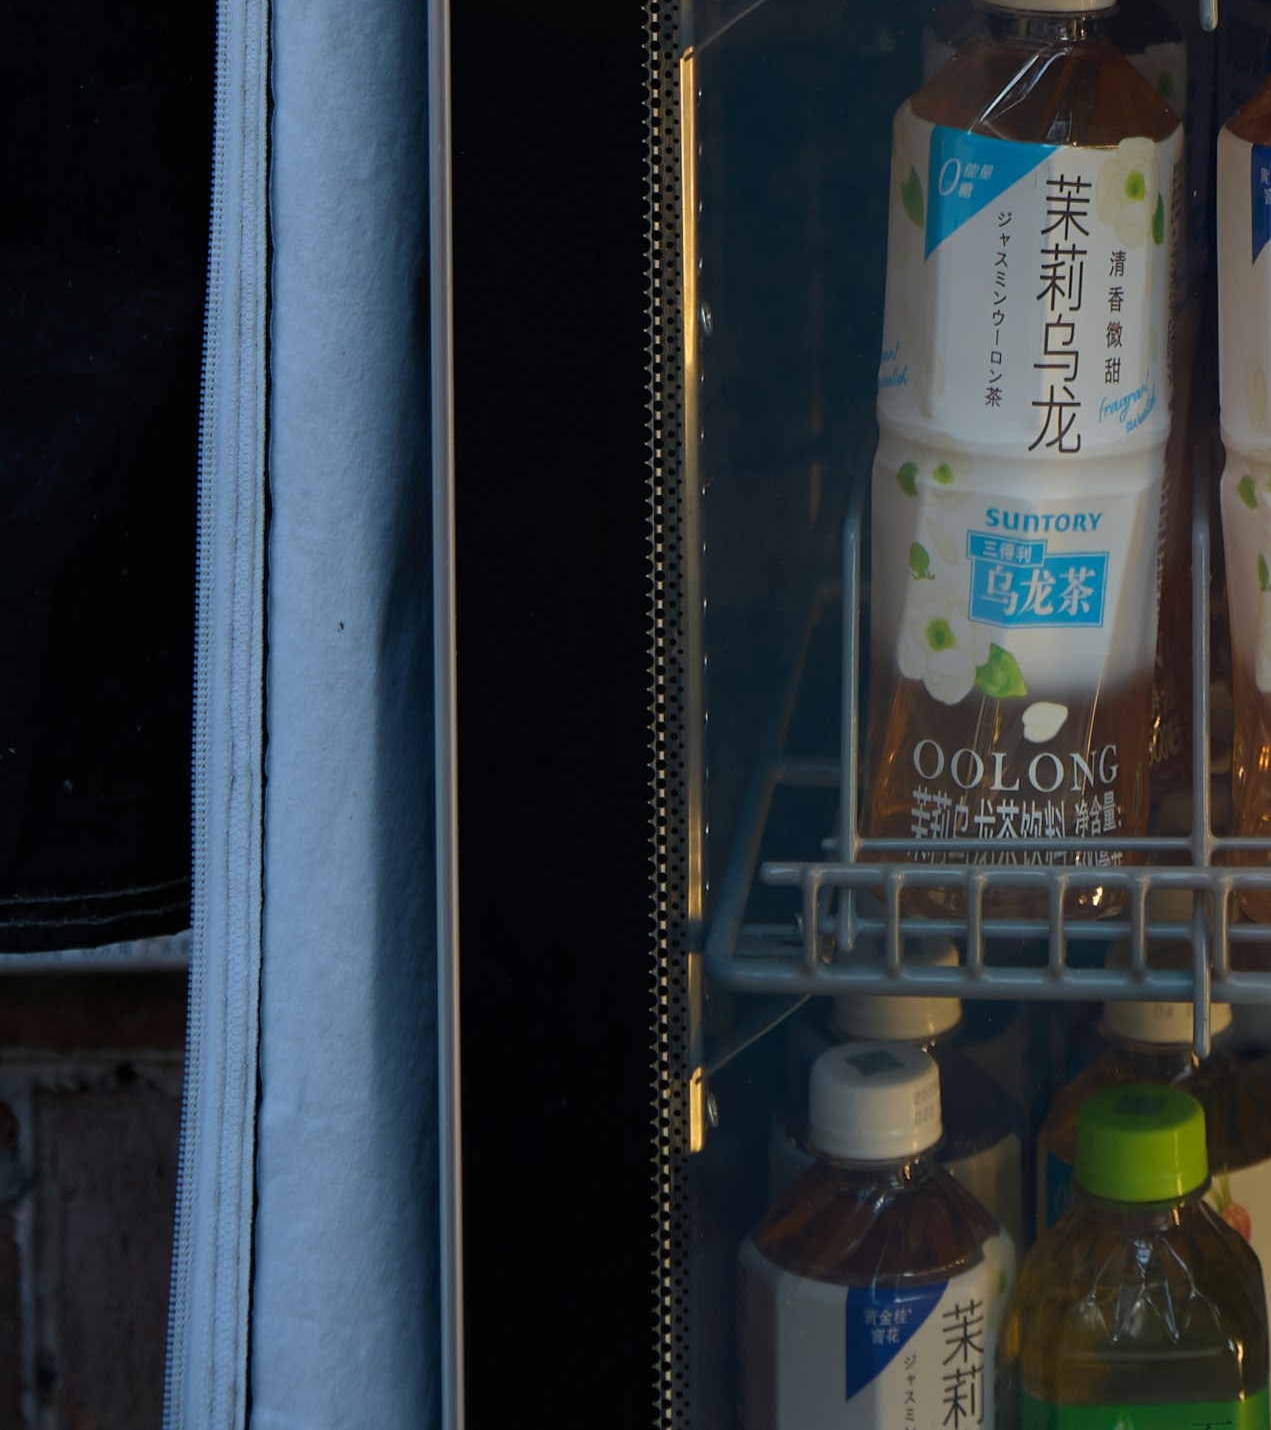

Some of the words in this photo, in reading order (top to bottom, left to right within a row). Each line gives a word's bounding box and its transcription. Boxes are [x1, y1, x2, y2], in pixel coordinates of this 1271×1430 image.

[984, 211, 1013, 408] ジャスミンウーロン茶
[1027, 172, 1092, 455] 茉莉乌龙
[1103, 249, 1128, 386] 清香微甜
[985, 508, 1103, 535] SUNTORY
[981, 566, 1099, 619] 乌龙茶
[912, 738, 1119, 794] OOLONG
[941, 1296, 985, 1429] 茉莉
